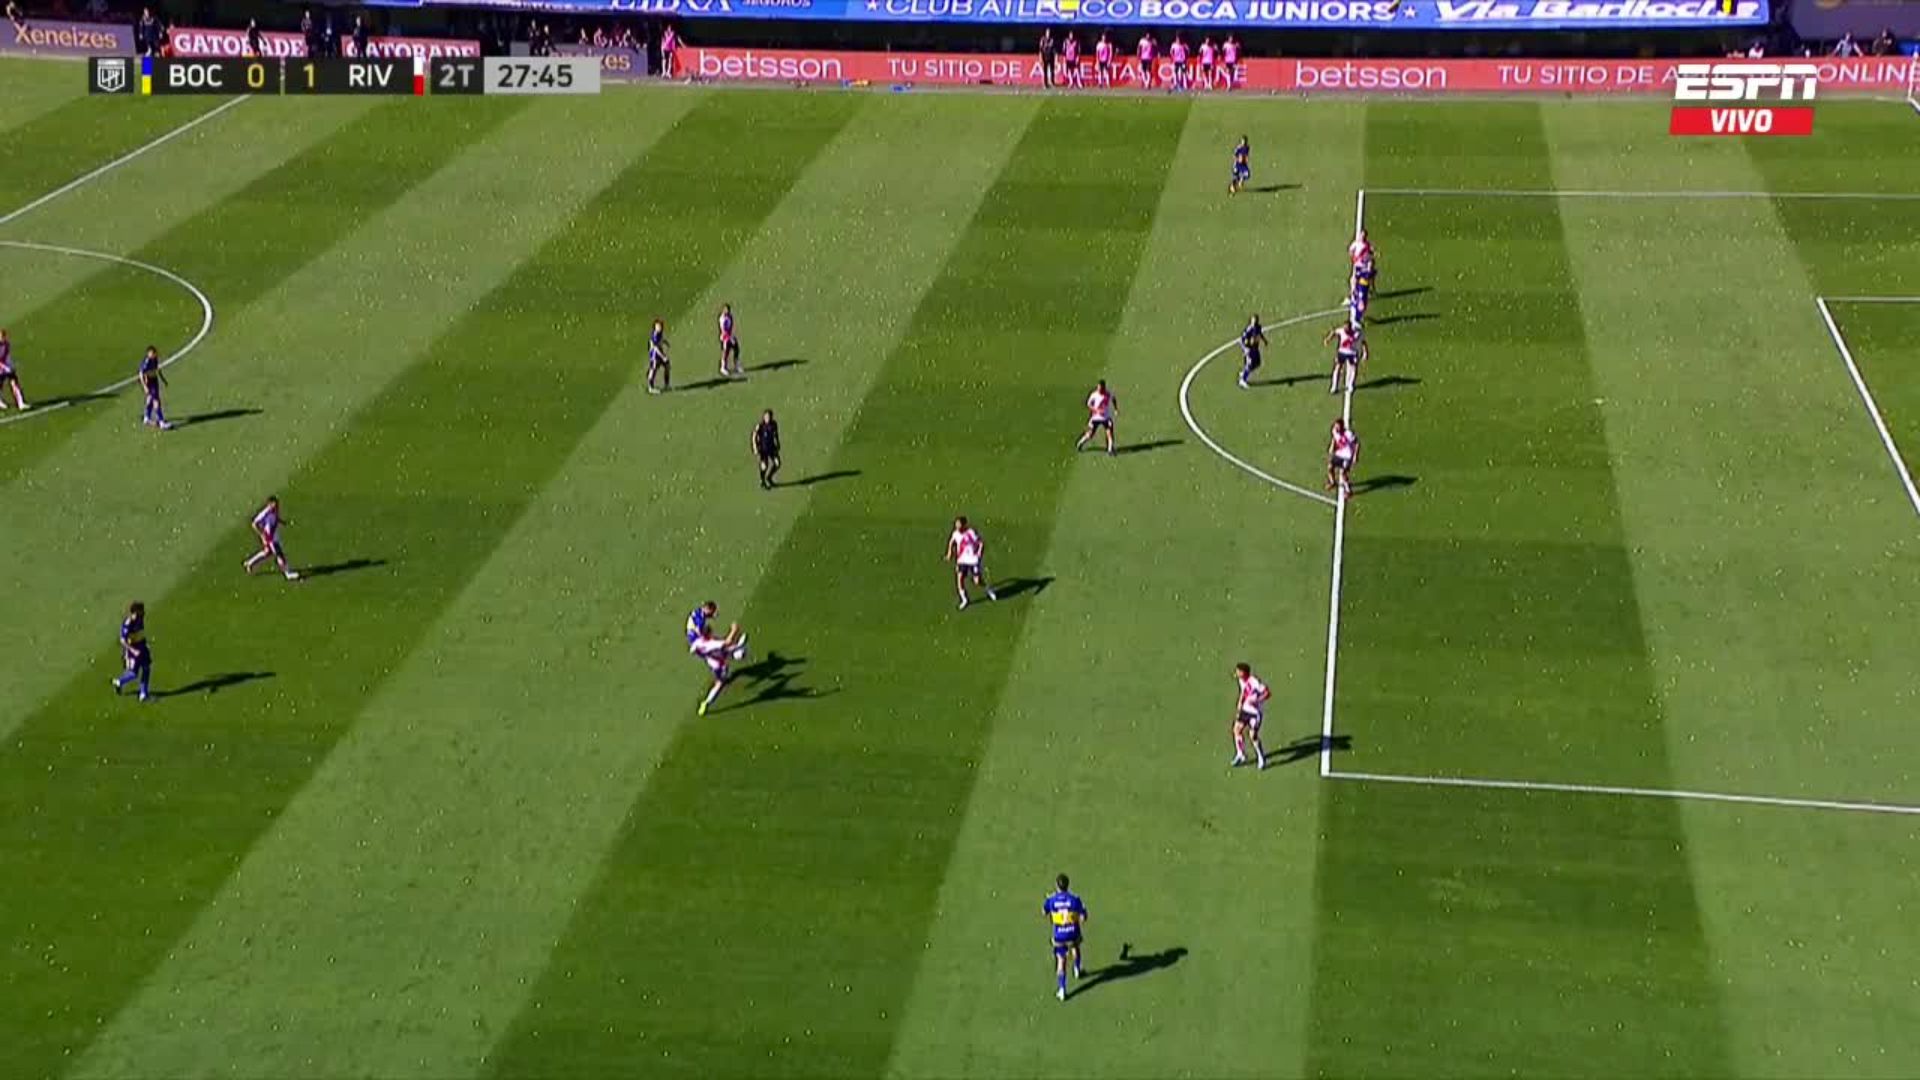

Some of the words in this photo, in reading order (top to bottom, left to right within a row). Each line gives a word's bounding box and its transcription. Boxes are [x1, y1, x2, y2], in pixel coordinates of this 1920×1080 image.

[885, 0, 973, 15] CLUB
[1139, 0, 1238, 19] BOCA
[1244, 1, 1396, 21] JUNIORS
[15, 24, 118, 49] Xeneizes
[700, 50, 841, 78] betsson
[888, 59, 917, 76] TU
[925, 60, 983, 77] SITIO
[991, 61, 1021, 77] DE
[1296, 61, 1447, 88] betsson
[1498, 65, 1531, 83] TU
[1540, 66, 1608, 84] SITIO
[1616, 66, 1654, 84] DE
